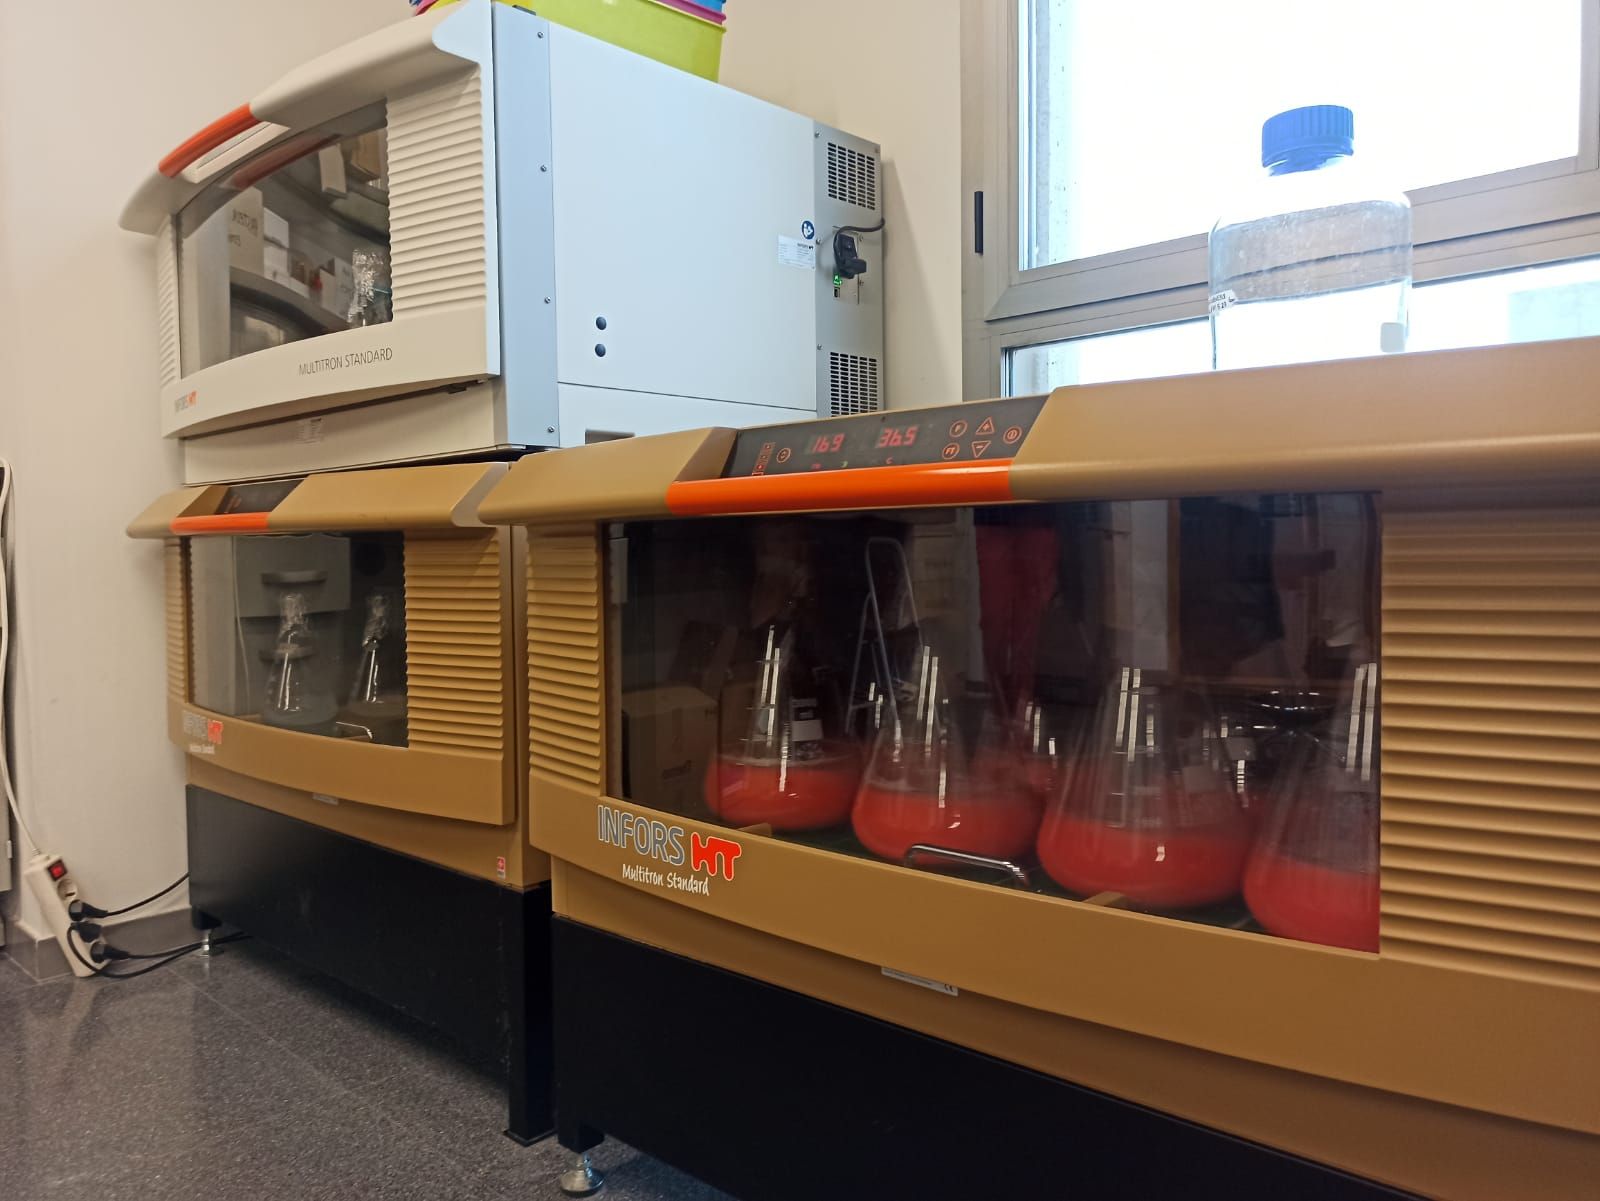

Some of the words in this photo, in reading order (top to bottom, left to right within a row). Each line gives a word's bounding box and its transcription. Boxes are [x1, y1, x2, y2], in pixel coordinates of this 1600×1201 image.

[299, 356, 343, 375] MULTITRON
[345, 347, 393, 368] STANDARD
[597, 805, 685, 866] INFORS
[691, 832, 742, 881] HT
[622, 863, 664, 887] Multitron
[666, 872, 710, 897] Standard
